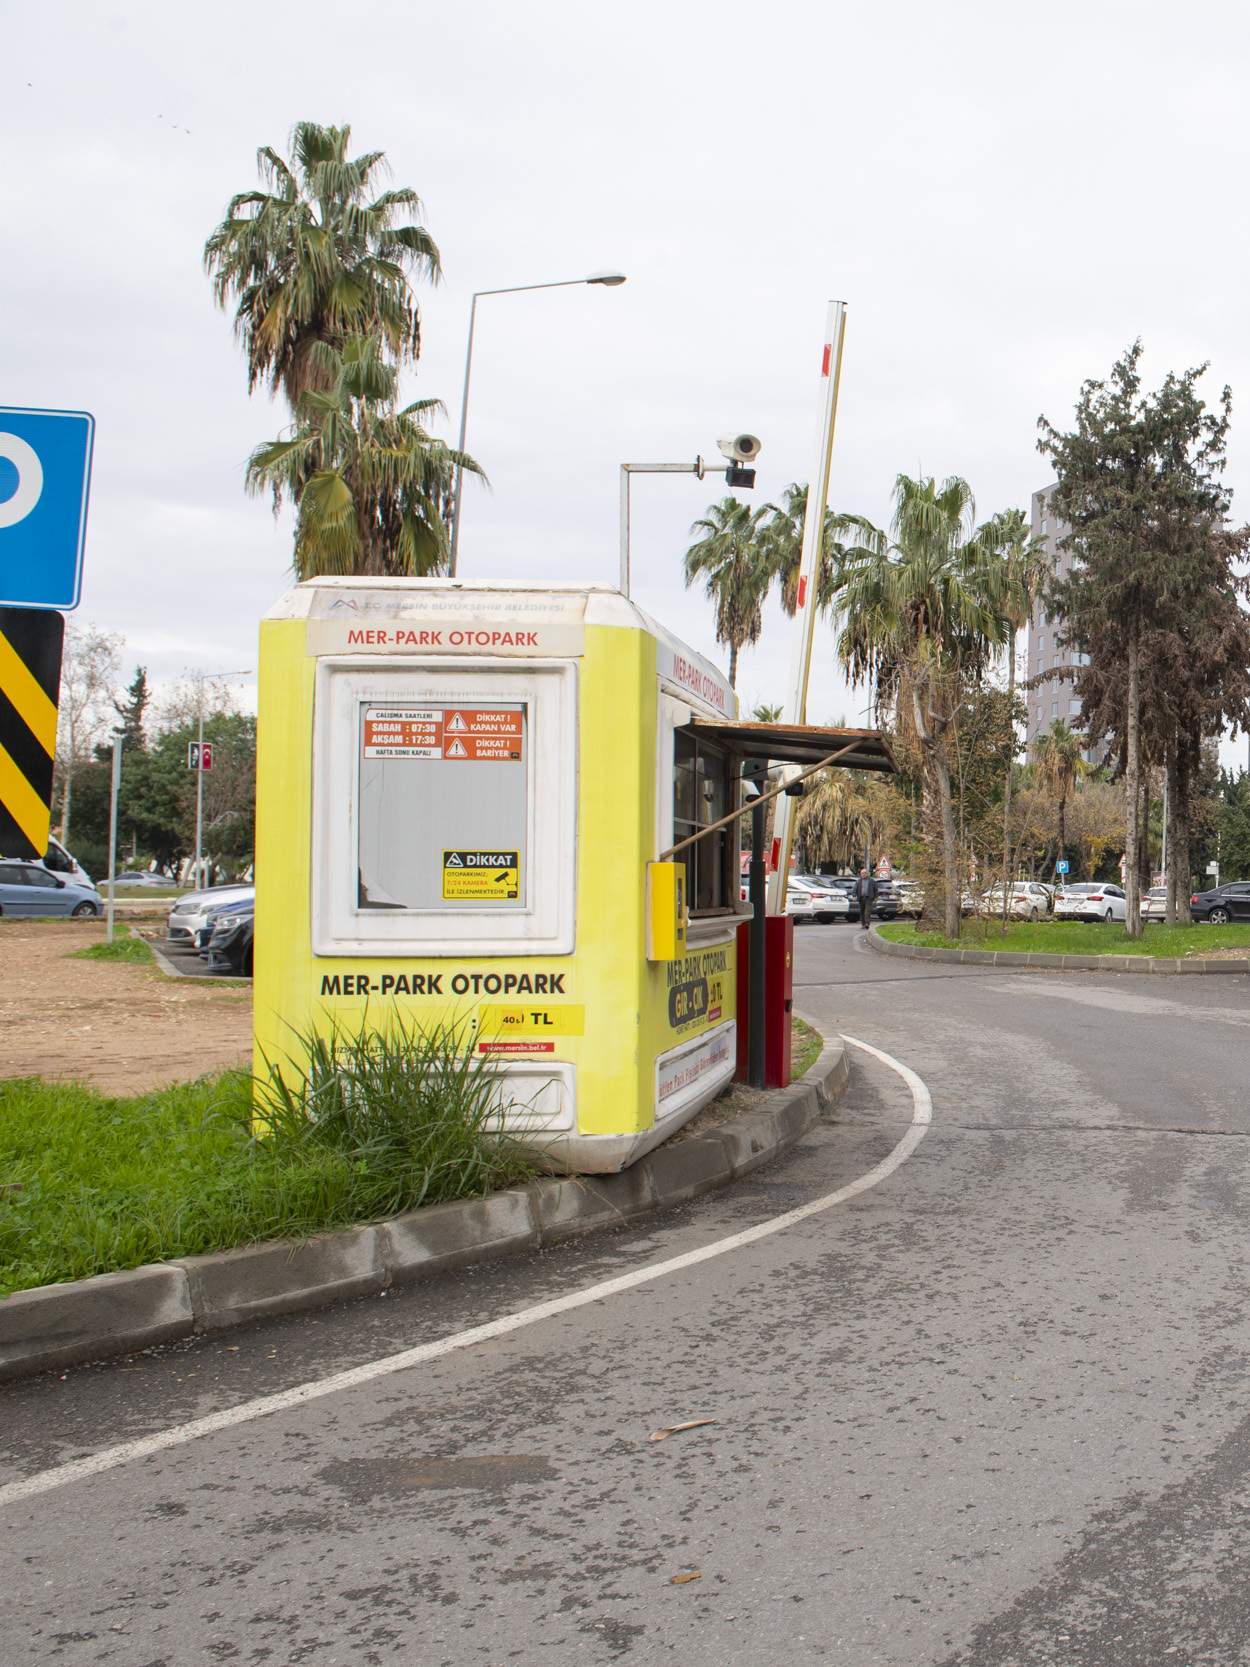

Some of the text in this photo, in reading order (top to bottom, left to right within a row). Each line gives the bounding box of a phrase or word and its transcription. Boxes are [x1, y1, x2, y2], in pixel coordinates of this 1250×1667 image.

[347, 630, 538, 646] MER-PARK OTOPARK
[673, 653, 725, 710] MER-PARK OTOPARK
[476, 713, 505, 722] DİKKAT
[372, 723, 402, 732] SABAH
[411, 724, 436, 733] 07:30
[470, 723, 517, 732] KAPAN VAR
[372, 734, 403, 744] AKŞAM
[411, 735, 436, 744] 17:30
[475, 738, 505, 747] DİKKAT
[476, 748, 509, 757] BARİYER
[466, 852, 513, 866] DİKKAT
[1058, 863, 1066, 872] P
[667, 949, 728, 988] MER-PARK OTOPARK
[321, 973, 566, 995] MER-PARK OTOPARK
[675, 985, 689, 1018] GİR
[530, 1012, 553, 1025] TL
[659, 1081, 672, 1098] ütfen
